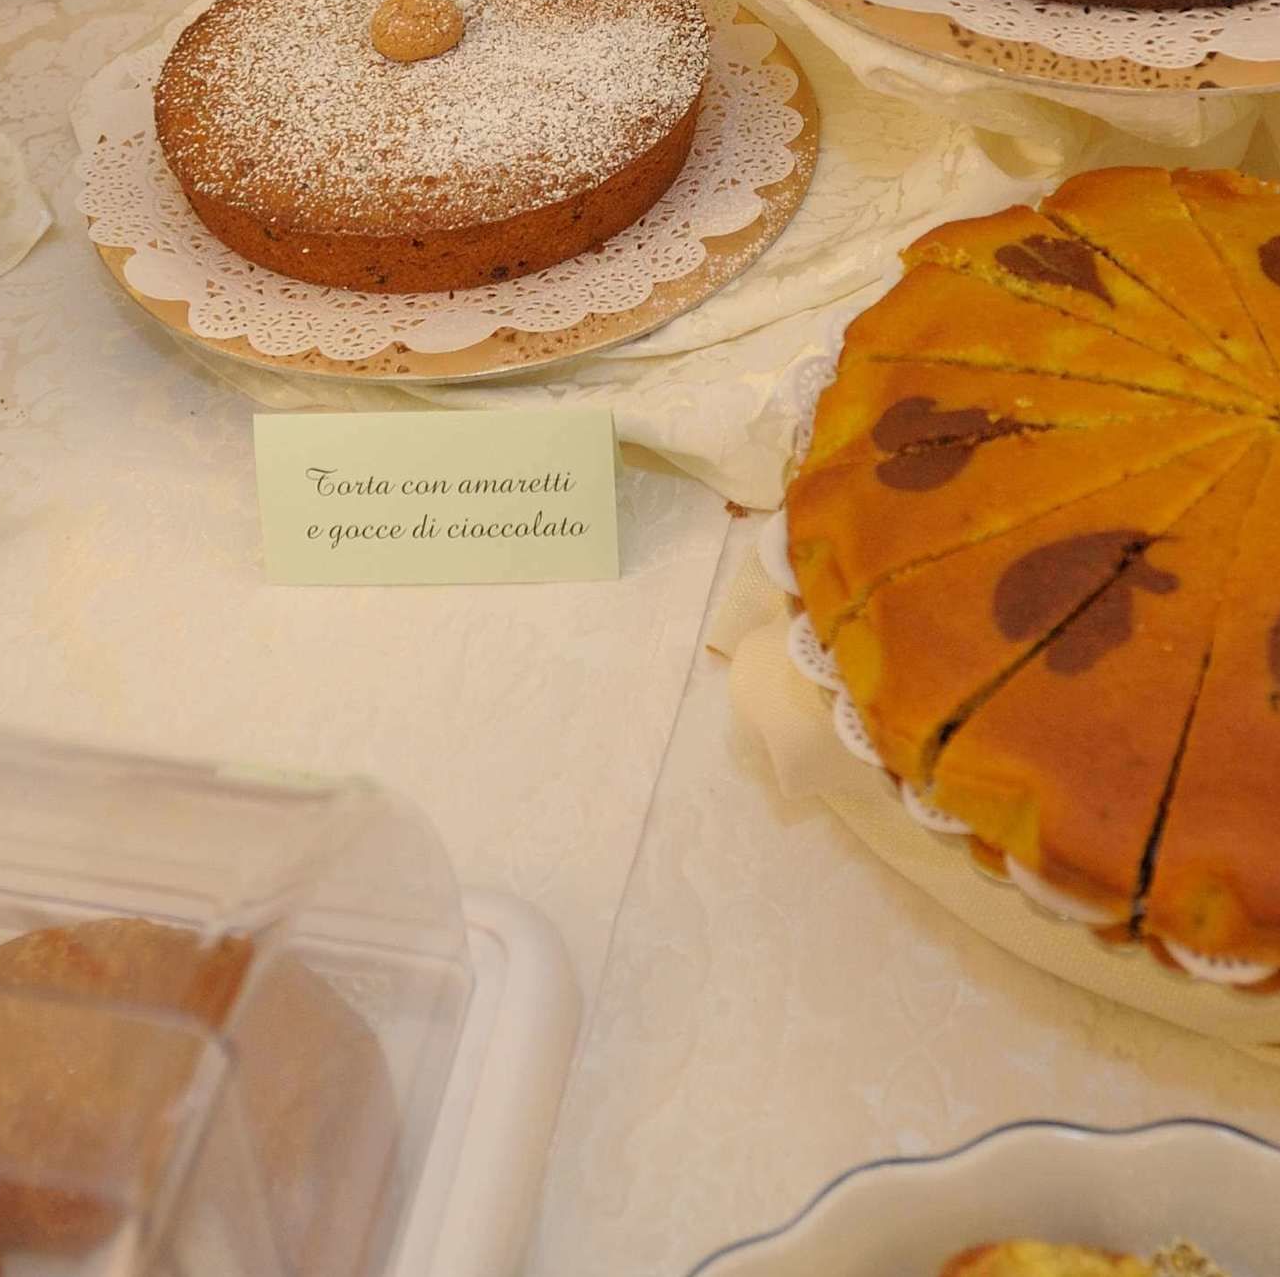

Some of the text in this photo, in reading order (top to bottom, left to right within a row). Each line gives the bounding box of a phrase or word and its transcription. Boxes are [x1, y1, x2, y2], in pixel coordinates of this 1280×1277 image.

[305, 467, 577, 496] Torta con amaretti
[307, 510, 590, 548] e gocce di cioccolato
